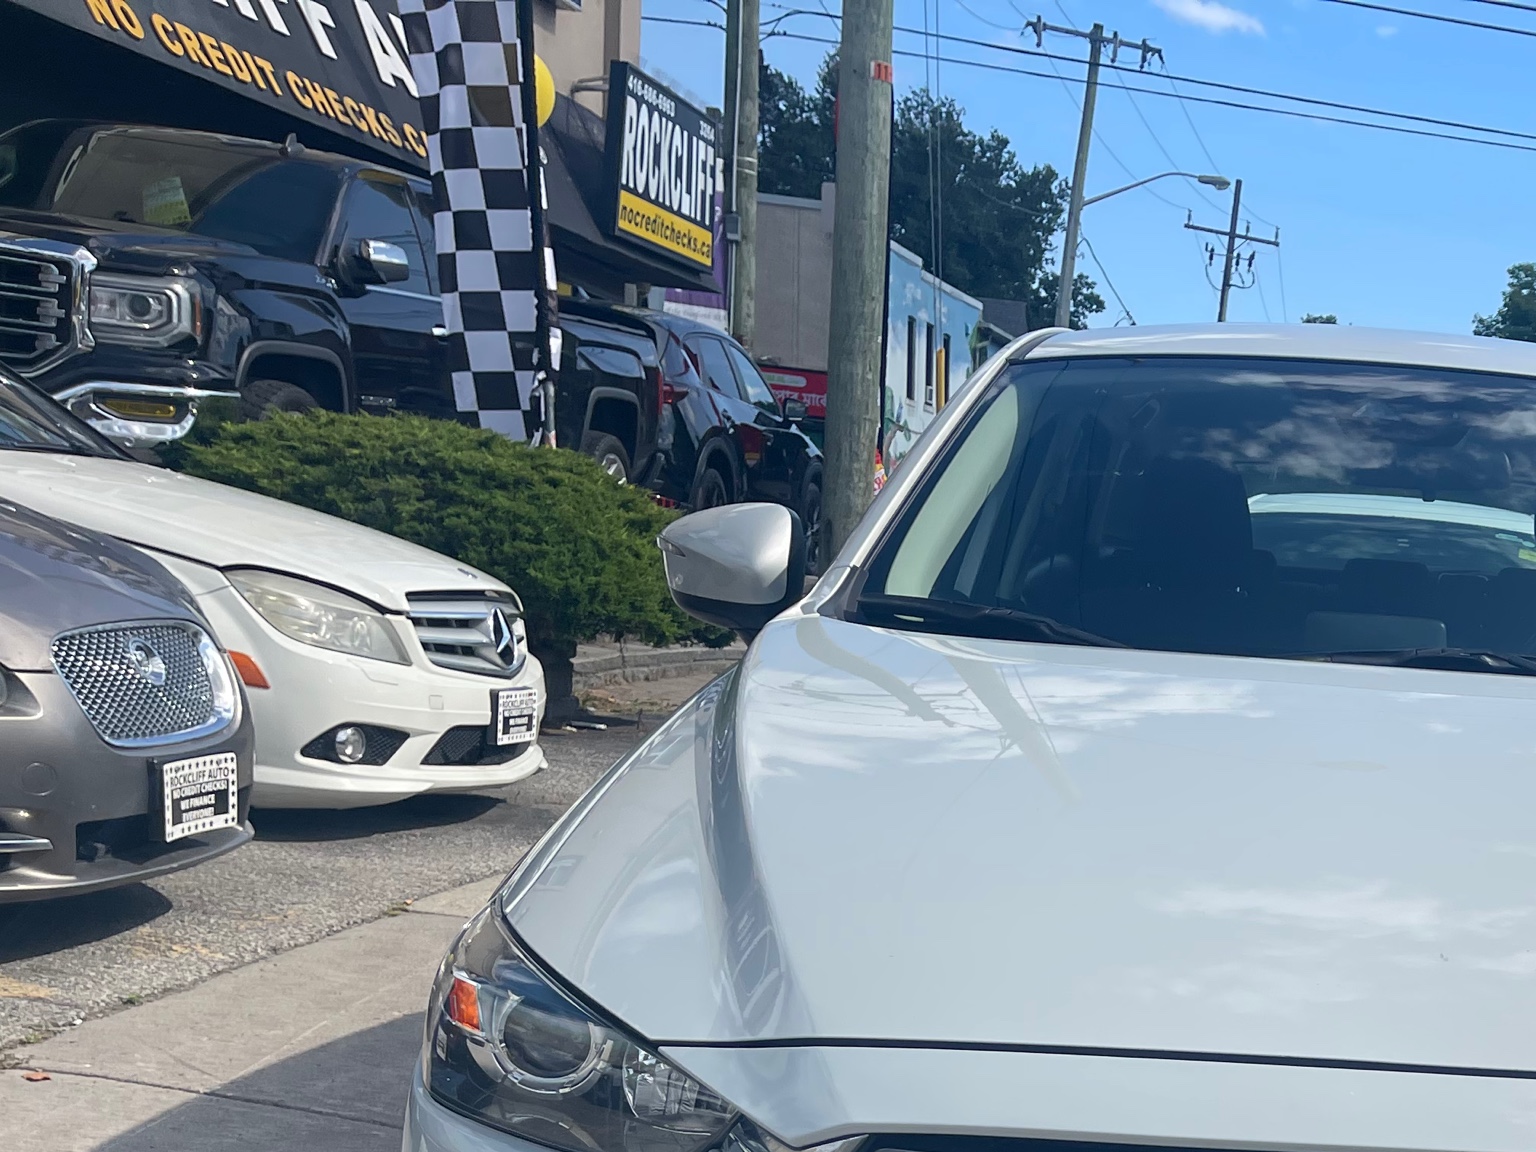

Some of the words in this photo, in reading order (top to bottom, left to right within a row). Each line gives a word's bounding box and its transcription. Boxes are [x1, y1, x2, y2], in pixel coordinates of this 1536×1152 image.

[85, 0, 145, 39] NO
[150, 13, 283, 97] CREDIT
[285, 70, 428, 158] CHECKS.C
[621, 95, 715, 226] ROCKCLIFF
[620, 203, 711, 259] nocreditchecks.ca
[170, 770, 207, 787] ROCKCLIFF
[208, 766, 230, 779] AUTO
